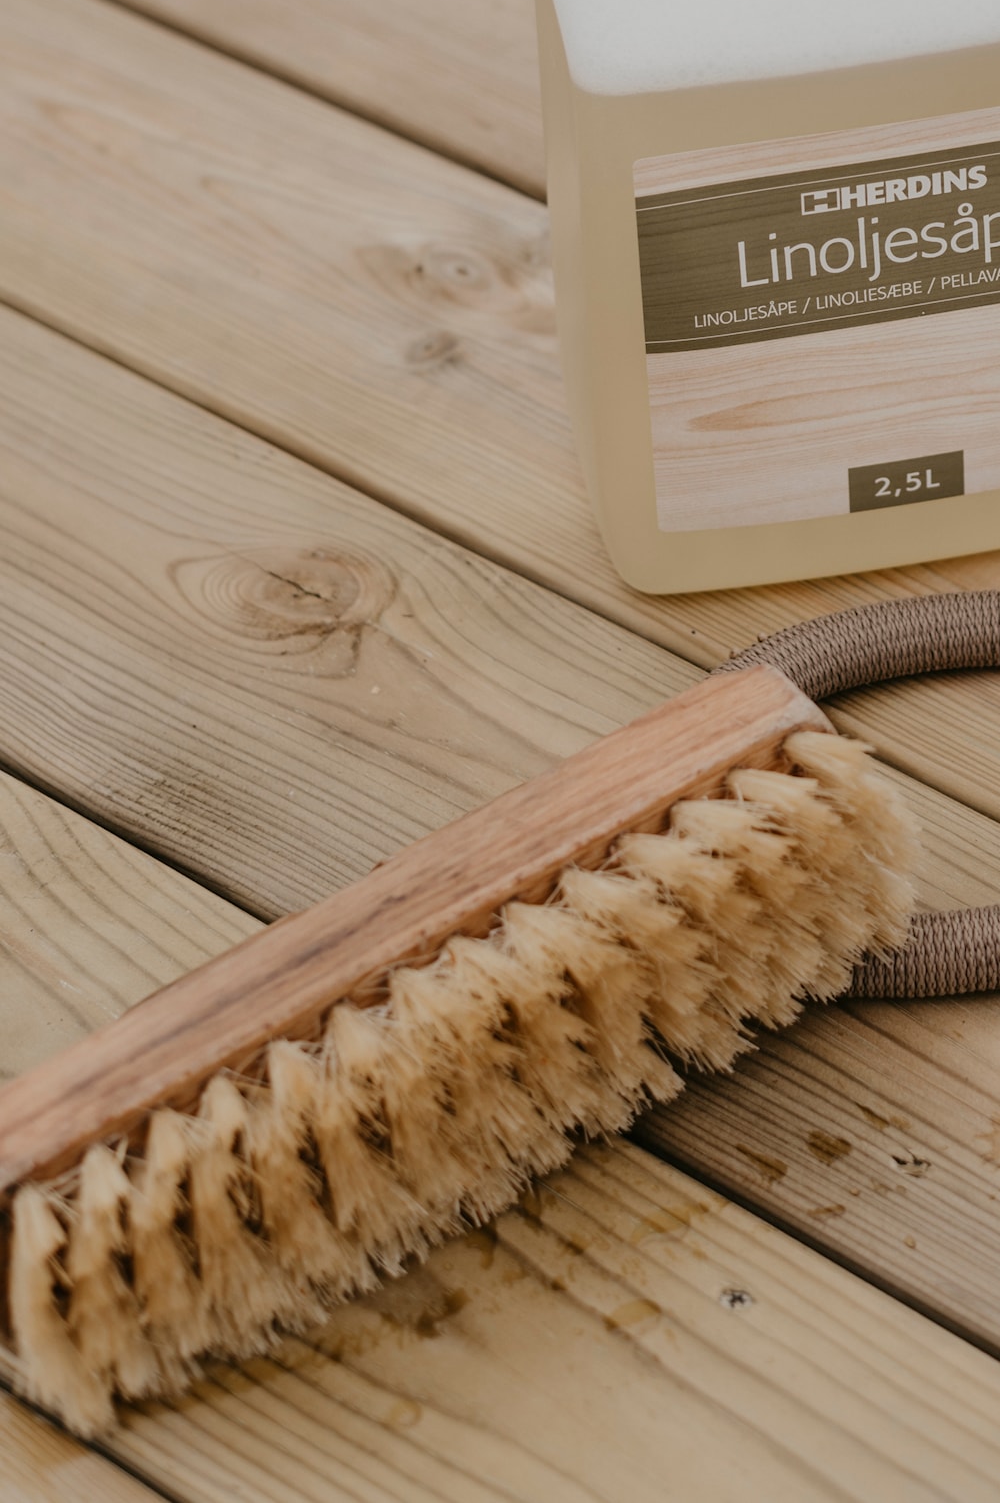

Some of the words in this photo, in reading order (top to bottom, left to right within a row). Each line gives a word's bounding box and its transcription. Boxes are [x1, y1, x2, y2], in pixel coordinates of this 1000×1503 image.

[841, 165, 988, 210] HERDINS
[694, 300, 797, 328] LINOLJESÅPE
[816, 280, 922, 310] LINOLIESÆBE
[874, 469, 940, 497] 2,5L
